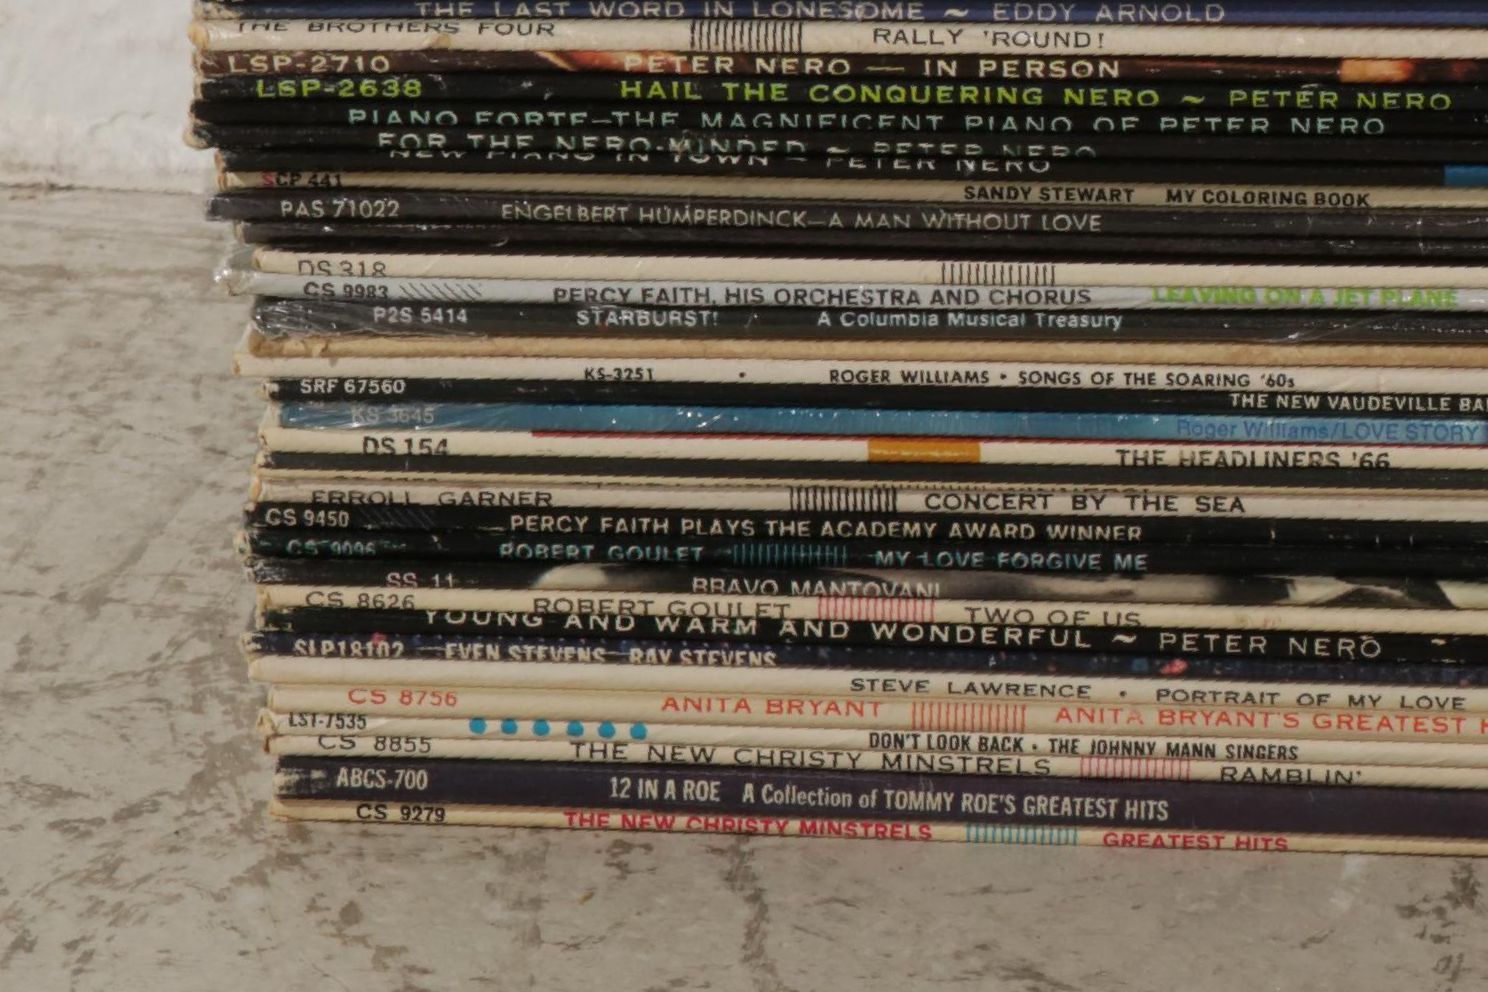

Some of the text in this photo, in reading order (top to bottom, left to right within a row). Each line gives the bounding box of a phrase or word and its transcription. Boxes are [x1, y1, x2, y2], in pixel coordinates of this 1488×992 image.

[256, 79, 1451, 109] LSP-2638 HAIL THE CONQUERING NERO PETER NERO
[818, 310, 831, 327] A
[839, 311, 939, 328] Columbia
[948, 312, 1028, 328] Musical
[1036, 312, 1122, 330] Treasury
[584, 367, 654, 382] KS-3251
[830, 370, 891, 386] ROGER
[901, 369, 989, 384] WILLIAMS
[1019, 370, 1084, 386] SONGS
[1091, 370, 1116, 386] OF
[1125, 372, 1159, 387] THE
[1165, 372, 1250, 388] SOARING
[925, 493, 1246, 513] CONCERT BY THE SEA
[850, 679, 1466, 710] STEVE LAWRENCE PORTRAIT OF MY LOVE
[336, 767, 1169, 820] ABCS-700 12 IN A ROE A Collection of TOMMY ROE'S GREATEST HITS
